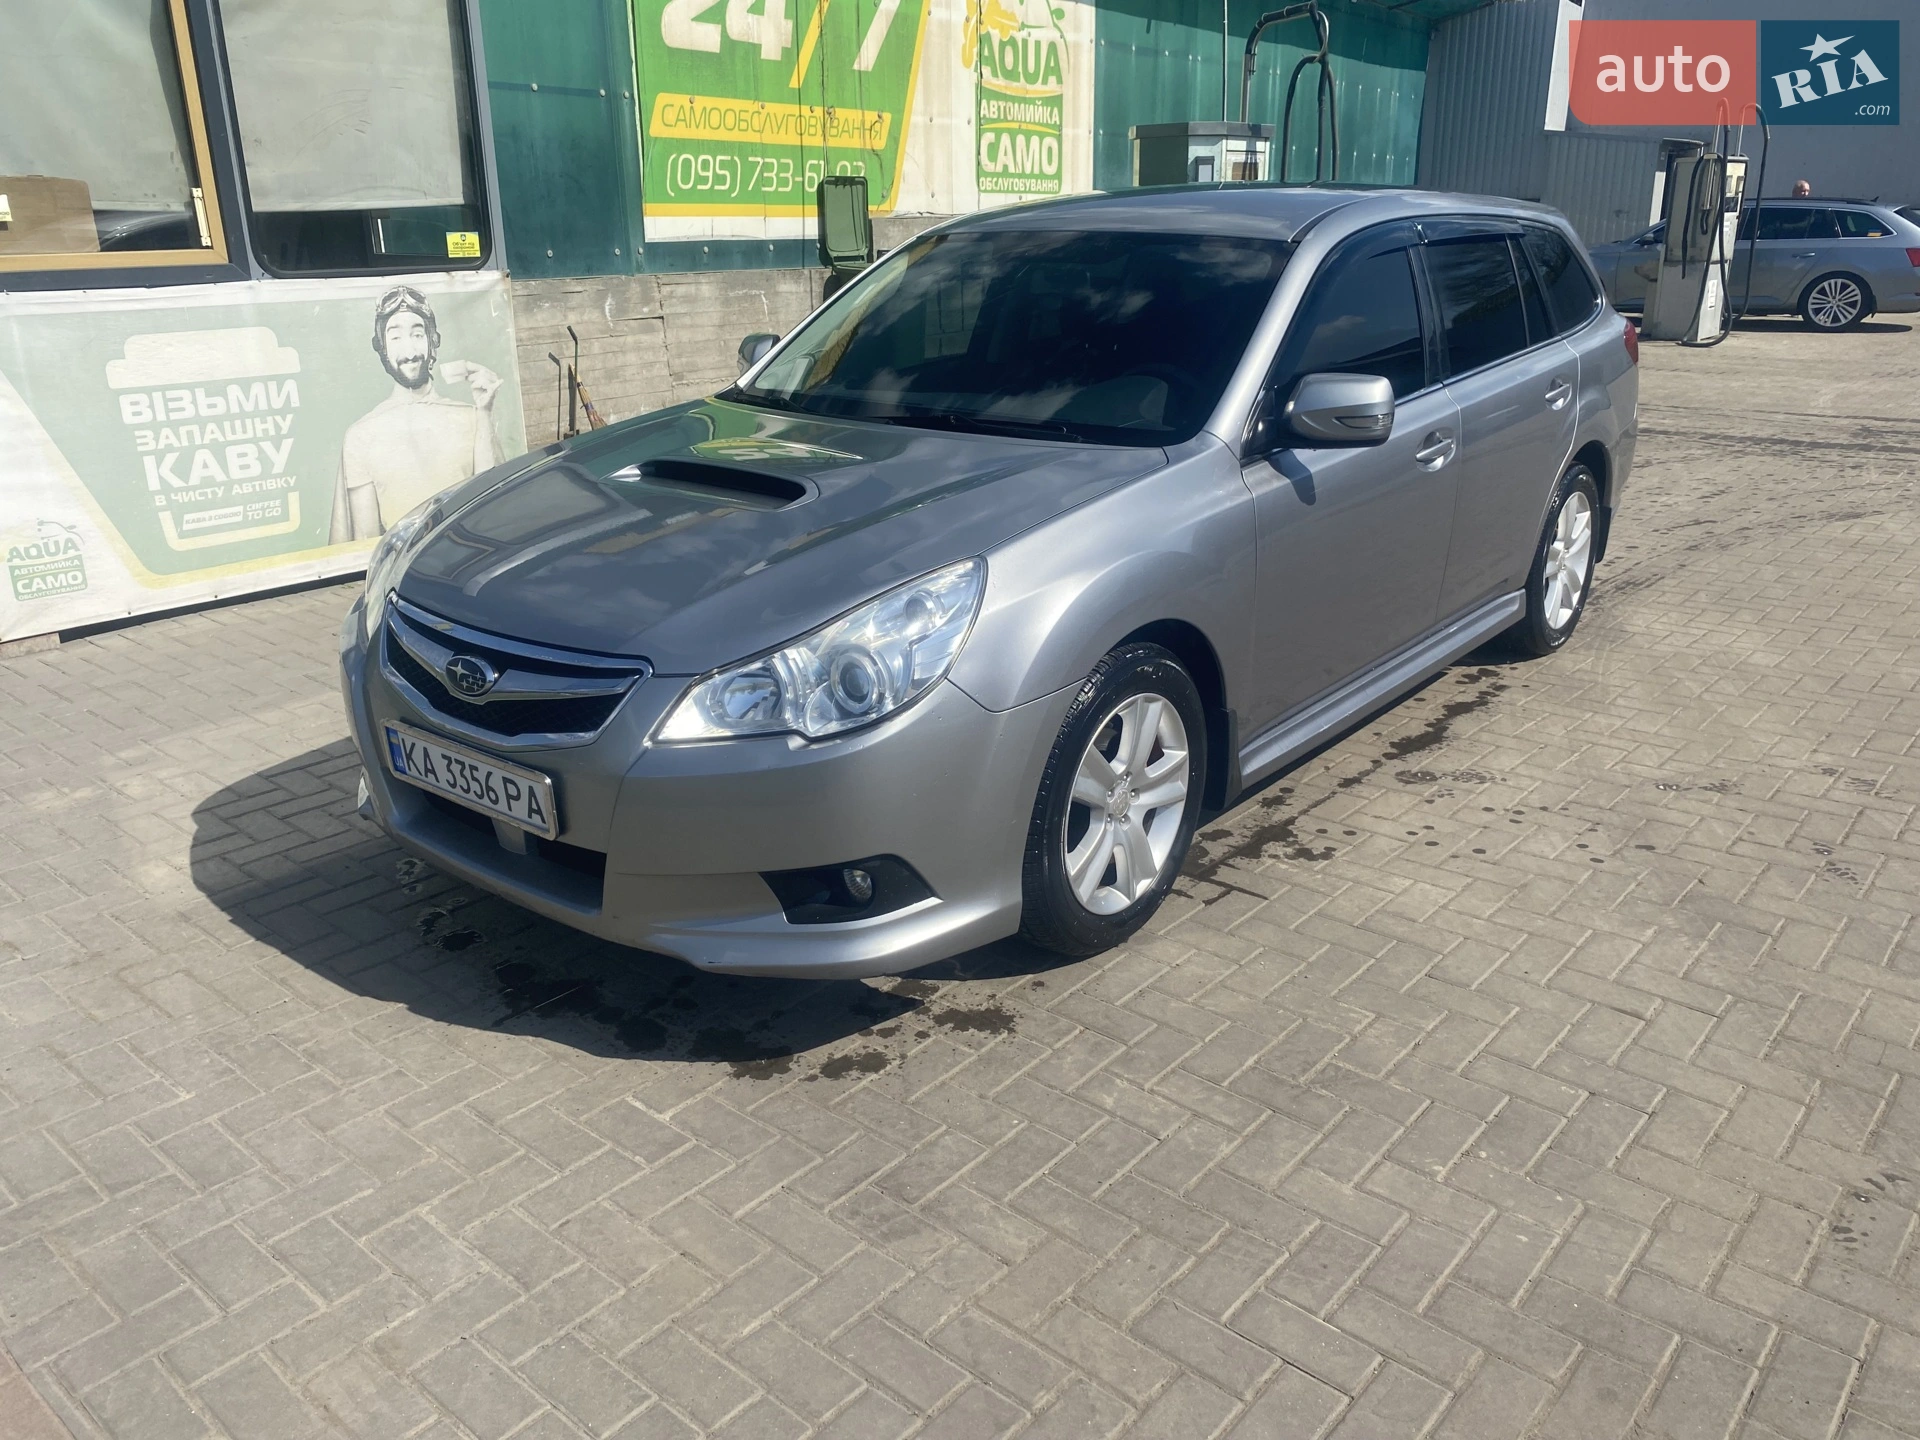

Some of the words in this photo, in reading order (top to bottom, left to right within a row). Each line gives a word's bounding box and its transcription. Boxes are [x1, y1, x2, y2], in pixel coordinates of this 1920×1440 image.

[974, 30, 1063, 85] AQUA
[661, 103, 883, 141] САМООБСЛУГОВУВАННЯ
[980, 98, 1060, 125] АВТОМИЙКА
[980, 132, 1059, 175] САМО
[666, 153, 741, 197] (095)
[979, 176, 1059, 192] ОБСЛУГОВУВАННЯ
[119, 379, 300, 425] ВІЗЬМИ
[134, 414, 294, 452] ЗАПАШНУ
[142, 438, 295, 492] КАВУ
[154, 494, 167, 506] В
[171, 485, 225, 504] ЧИСТУ
[231, 475, 297, 496] АВТІВКУ
[247, 510, 262, 520] TO
[265, 507, 282, 517] GO
[7, 537, 81, 563] AQUA
[13, 559, 80, 576] АВТОМИЙКА
[16, 570, 83, 593] САМО
[401, 738, 440, 783] KA
[441, 753, 499, 806] 3356
[501, 776, 547, 825] PA
